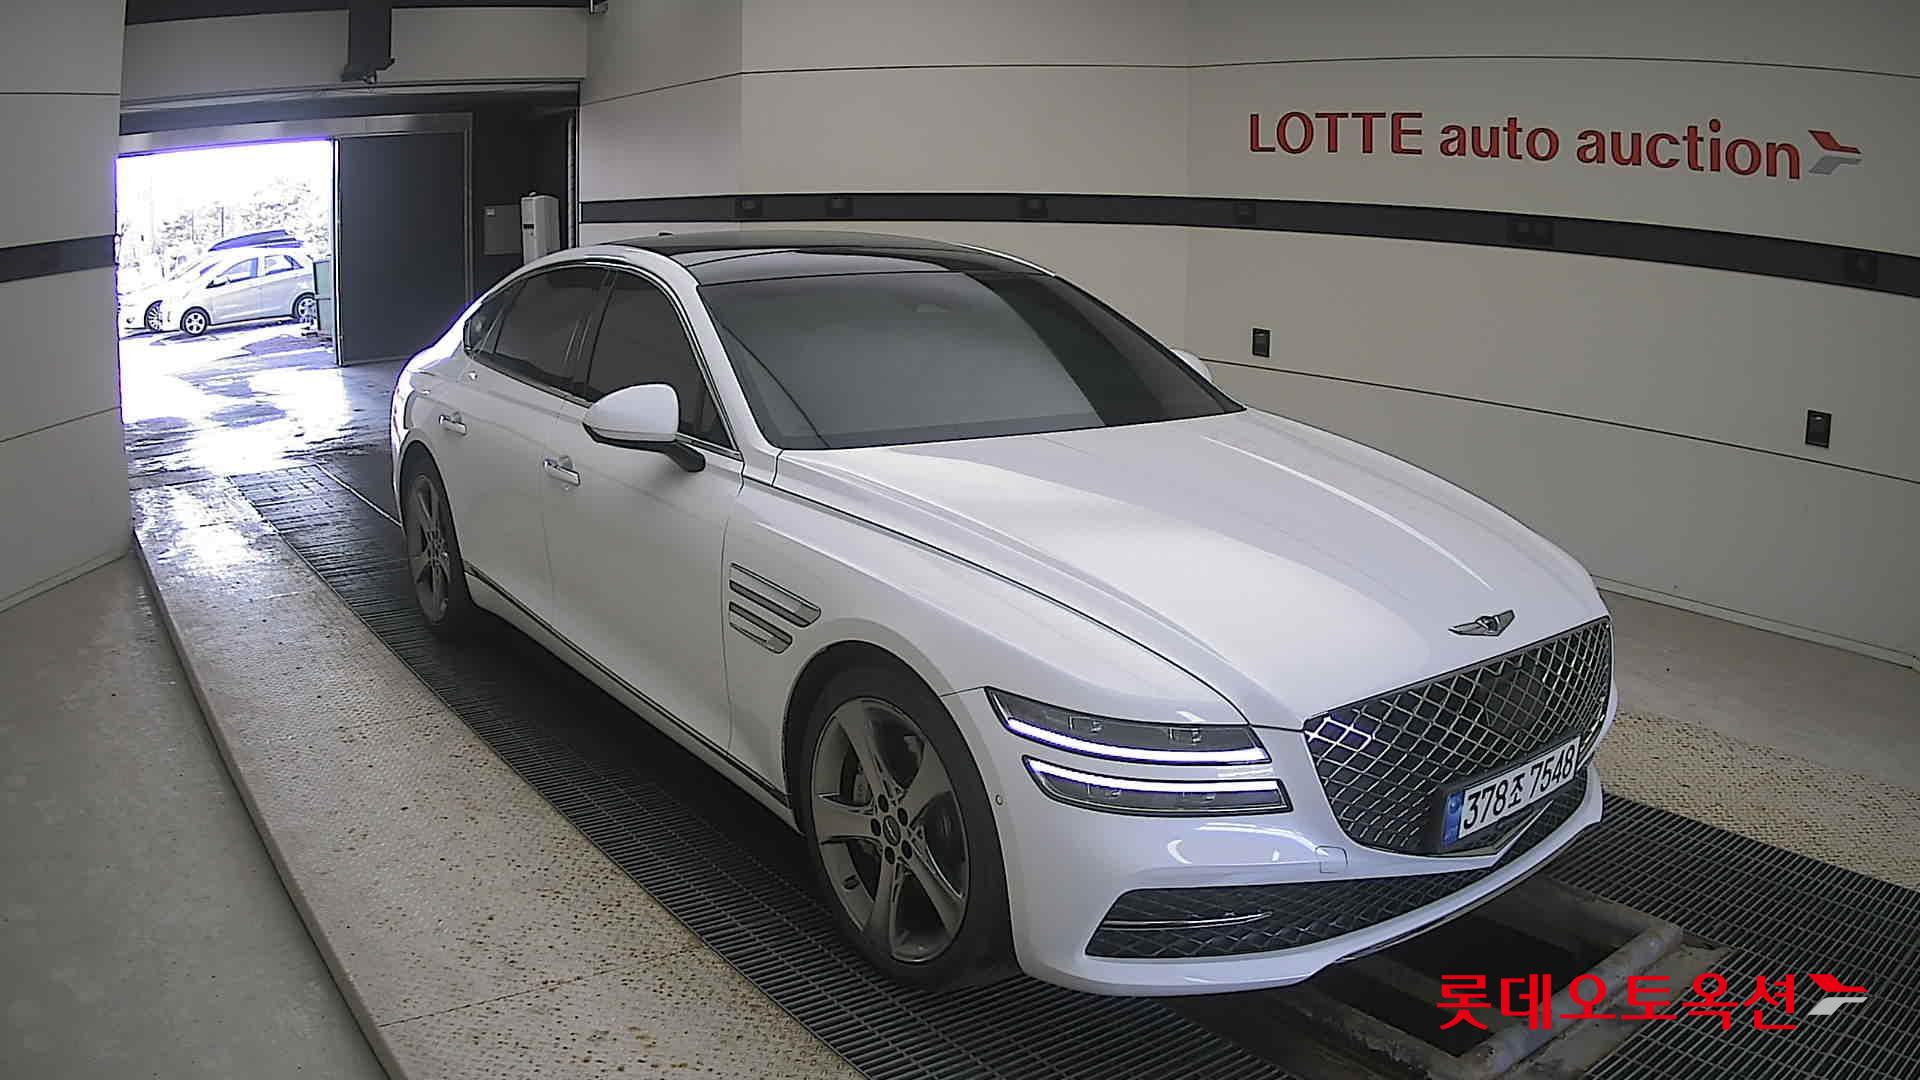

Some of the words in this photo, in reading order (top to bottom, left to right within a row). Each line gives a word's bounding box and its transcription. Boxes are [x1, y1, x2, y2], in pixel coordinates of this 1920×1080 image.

[1249, 111, 1424, 155] LOTTE
[1439, 117, 1560, 162] auto
[1576, 118, 1801, 180] auction
[1463, 772, 1525, 830] 378조
[1528, 744, 1576, 799] 7548
